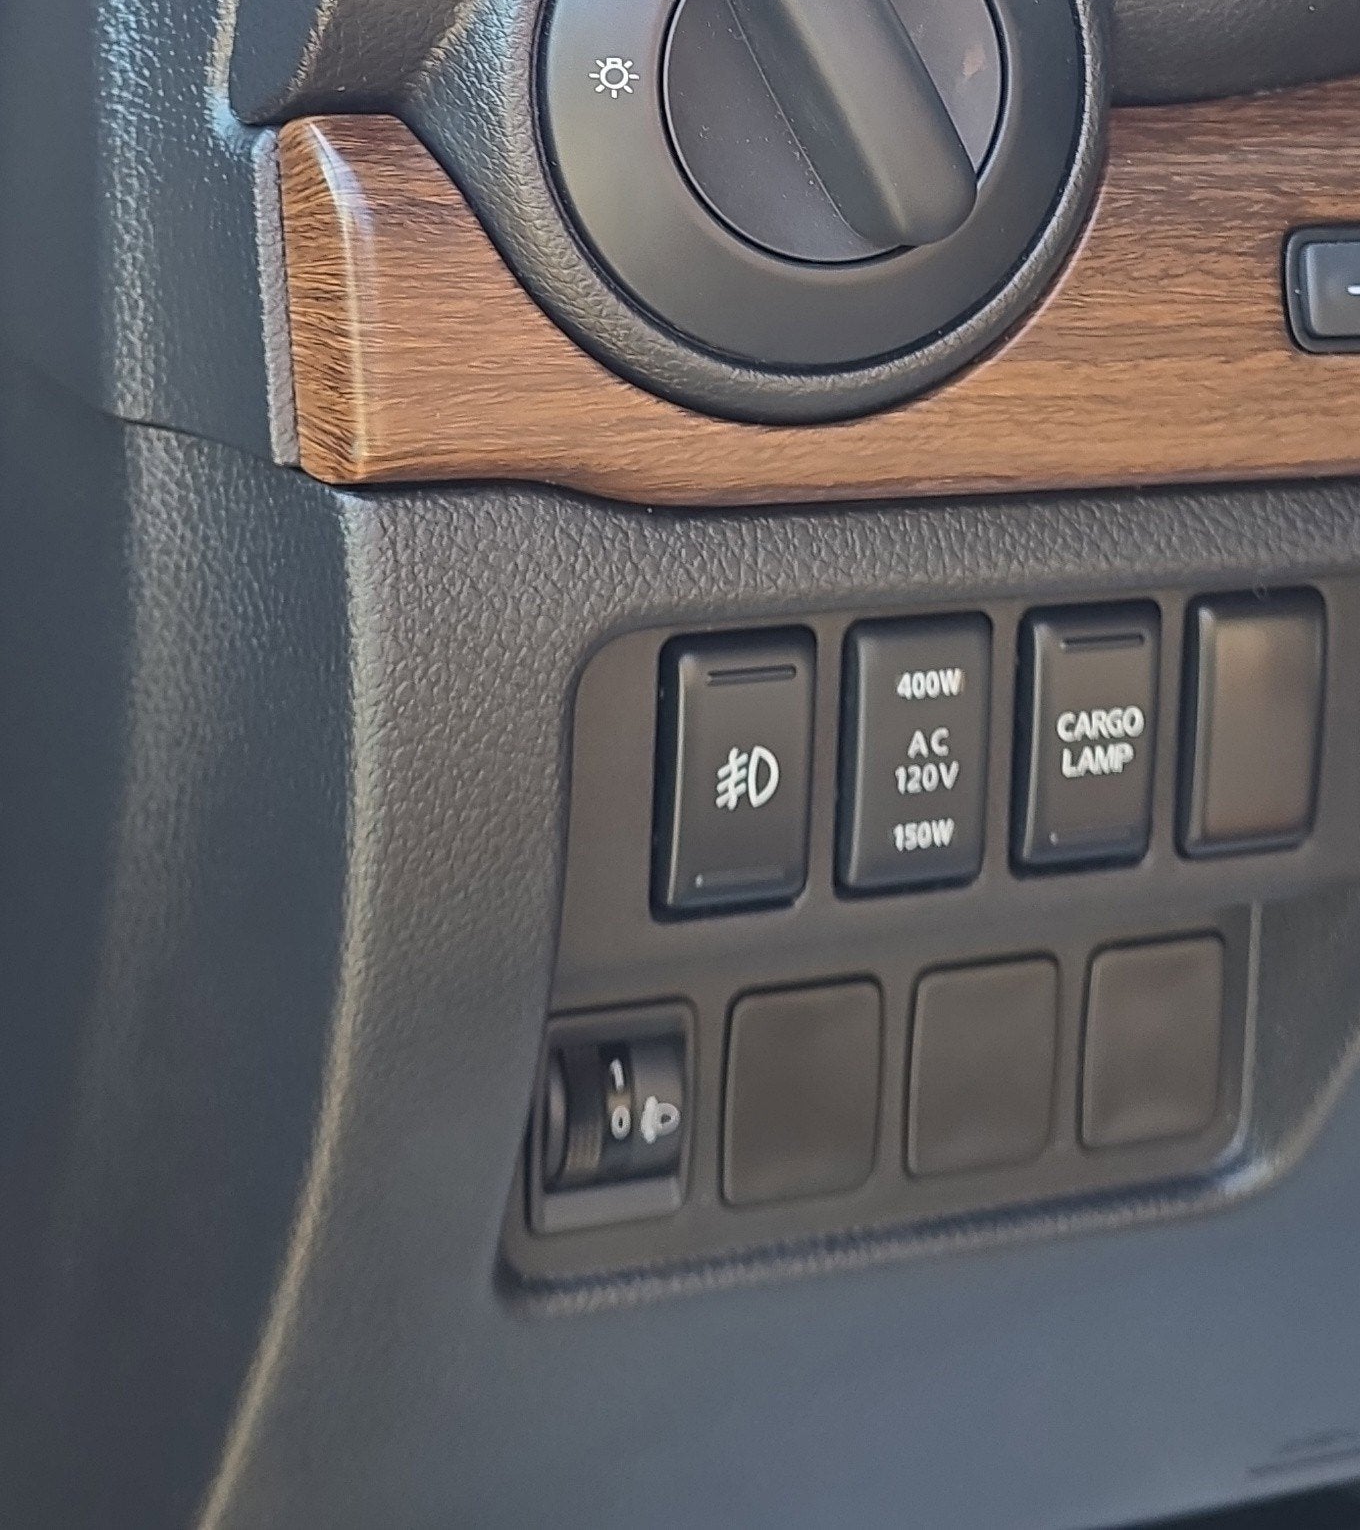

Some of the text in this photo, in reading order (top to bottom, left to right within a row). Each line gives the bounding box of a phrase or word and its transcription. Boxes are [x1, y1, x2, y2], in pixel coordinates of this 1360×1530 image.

[895, 666, 963, 701] 400W
[1055, 705, 1146, 743] CARGO
[906, 727, 950, 760] AC
[1061, 743, 1135, 779] LAMP
[894, 760, 960, 796] 120V
[892, 817, 956, 852] 150W
